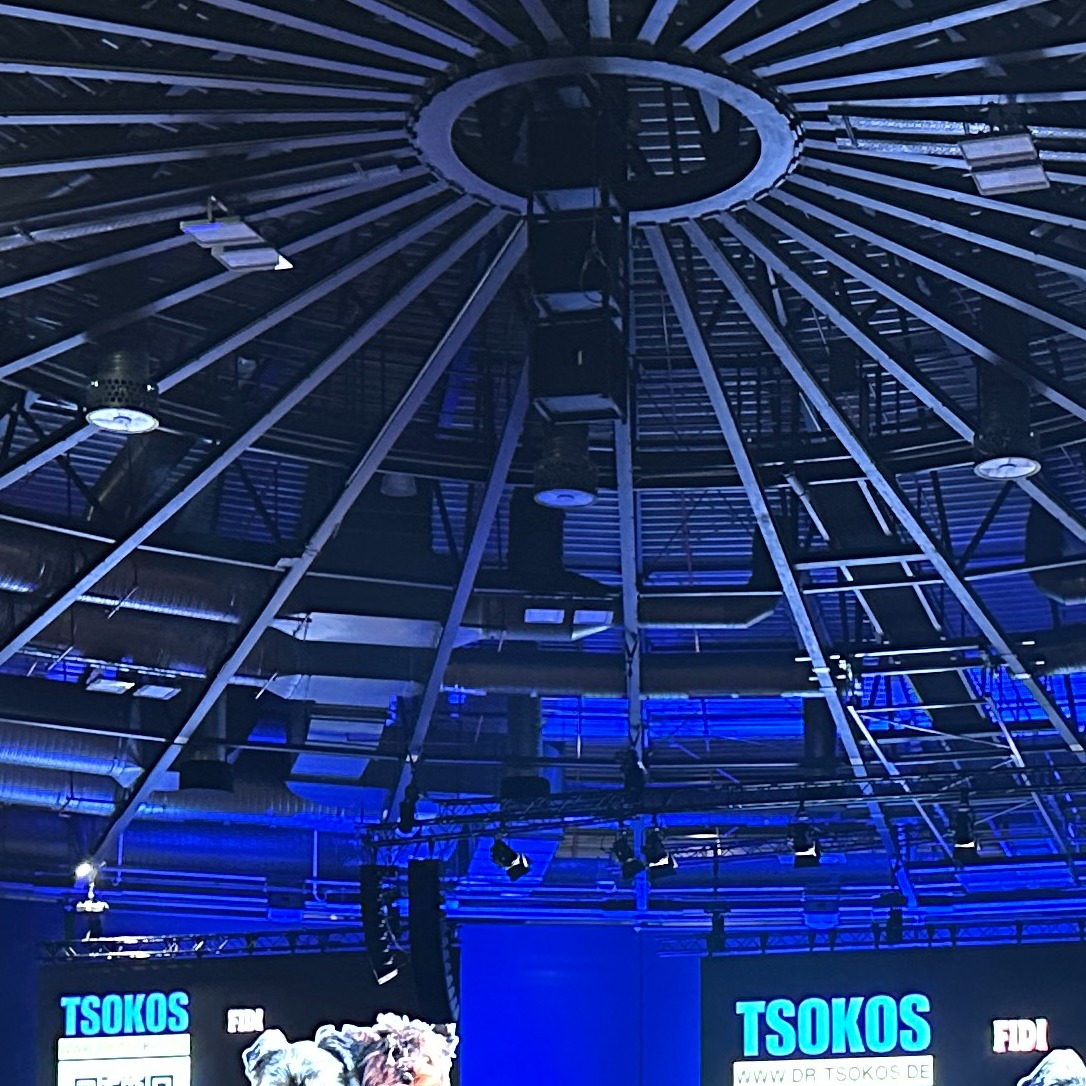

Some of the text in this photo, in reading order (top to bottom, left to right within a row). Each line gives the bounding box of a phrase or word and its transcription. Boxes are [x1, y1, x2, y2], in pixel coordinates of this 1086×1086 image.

[61, 991, 189, 1036] TSOKOS
[736, 993, 931, 1057] TSOKOS
[992, 1018, 1048, 1053] FIDI
[825, 1064, 900, 1082] TSOKOS
